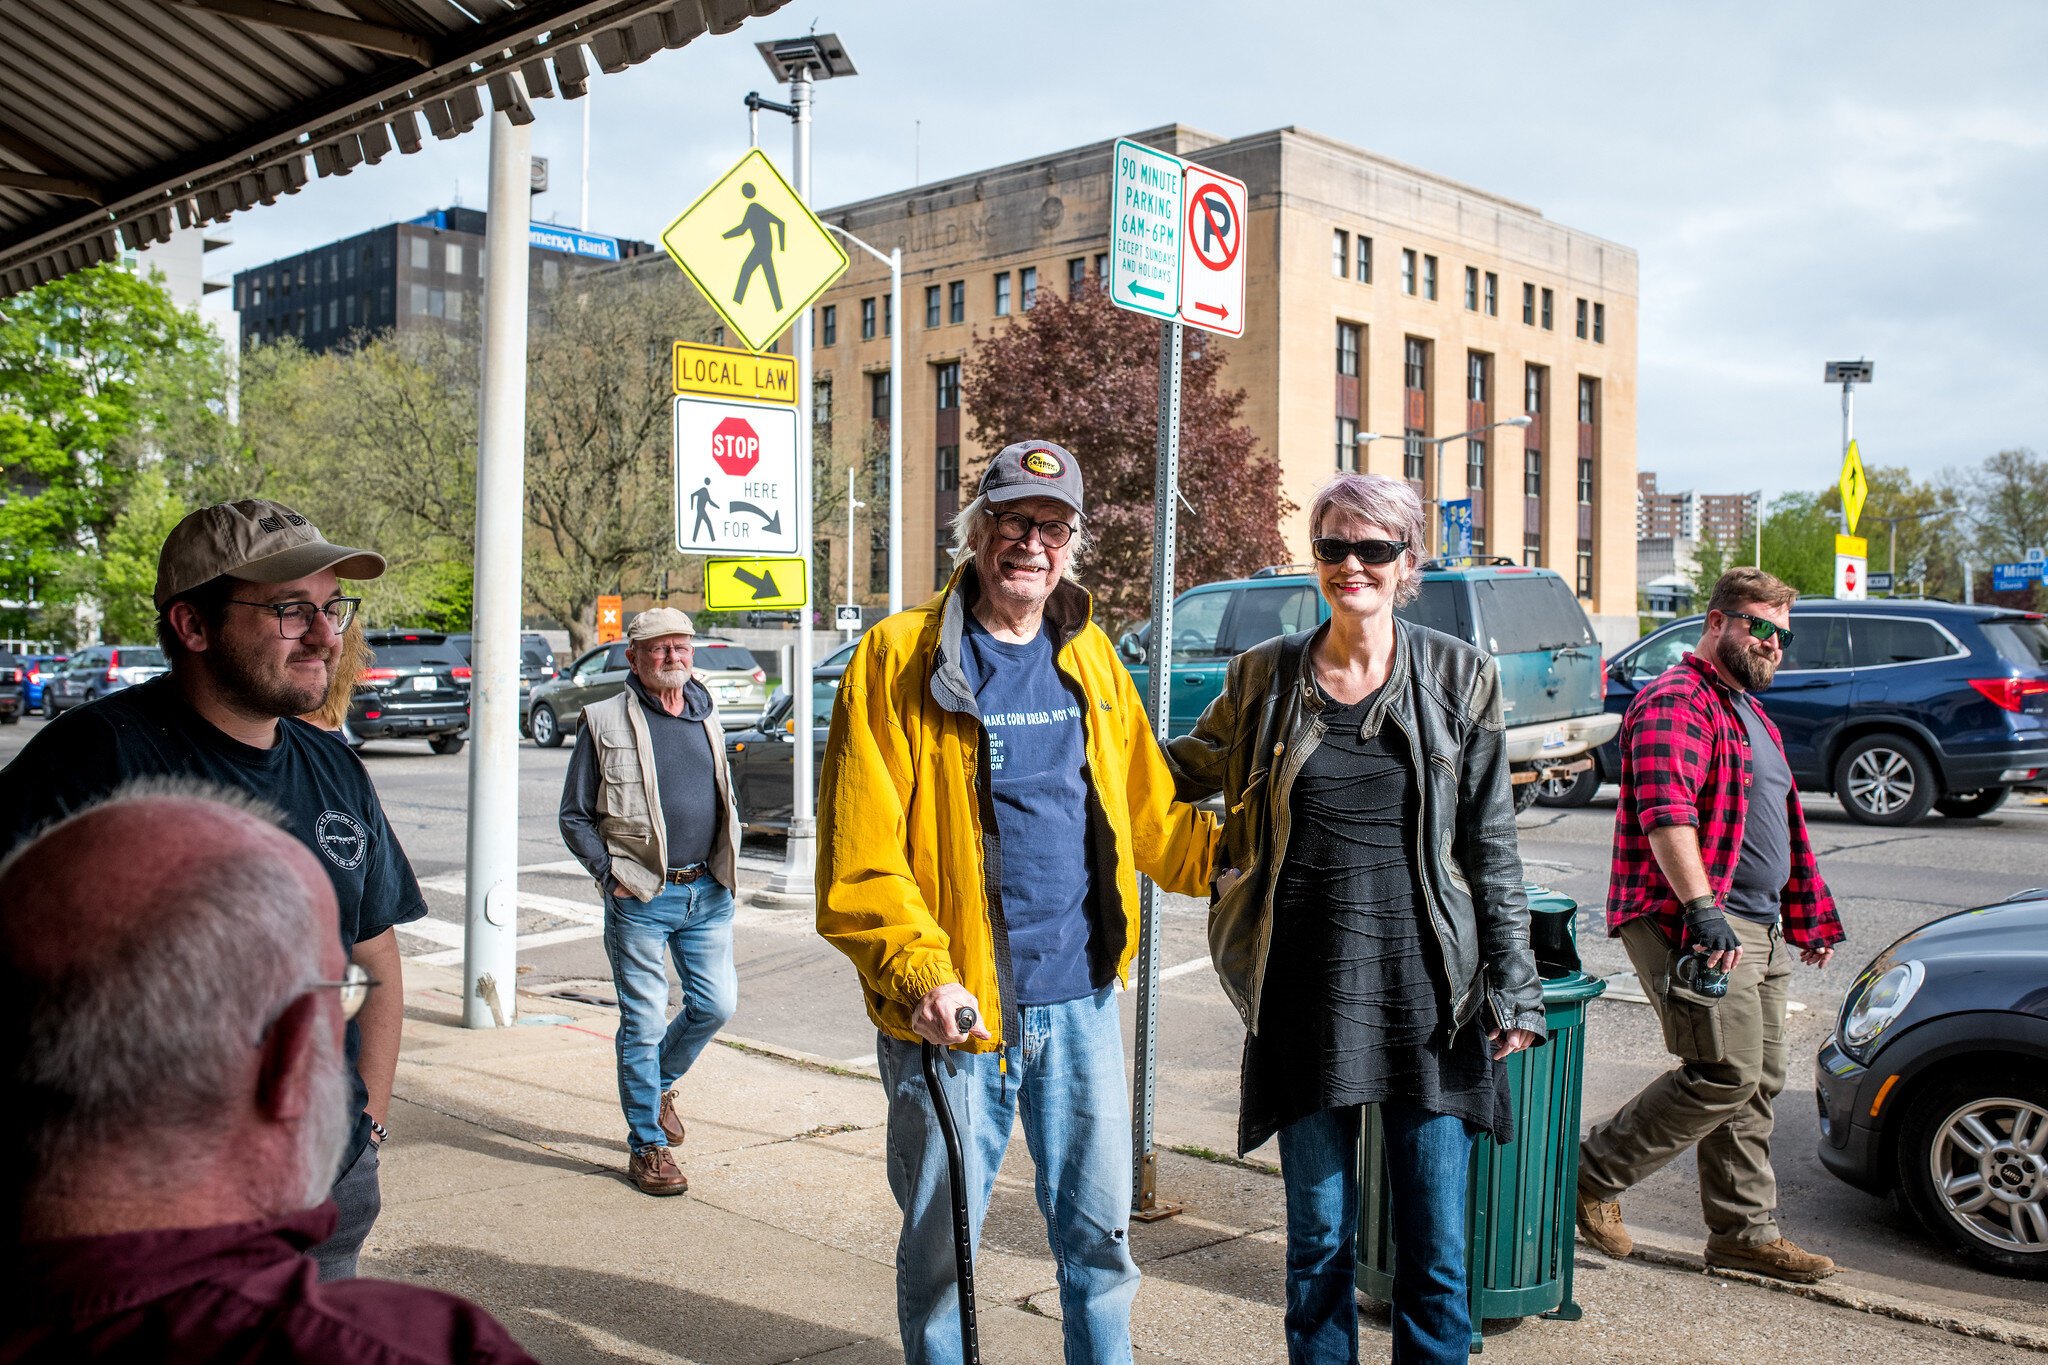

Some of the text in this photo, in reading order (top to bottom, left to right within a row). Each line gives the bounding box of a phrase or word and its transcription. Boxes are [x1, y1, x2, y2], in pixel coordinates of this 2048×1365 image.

[1122, 157, 1177, 194] 90 MINUTE
[1126, 186, 1171, 219] PARKING
[1121, 214, 1174, 246] 6AM-6PM
[577, 238, 611, 257] Bank
[1118, 238, 1176, 267] EXCEPT SUNDAYS
[1122, 258, 1171, 283] AND HOLIDAYS
[683, 357, 789, 391] LOCAL LAW
[713, 434, 759, 459] STOP
[744, 482, 778, 499] HERE
[724, 521, 750, 538] FOR
[2004, 565, 2043, 578] Michi
[983, 714, 1006, 727] MAKE
[1006, 712, 1026, 726] CORN
[1026, 711, 1053, 725] BREAD,
[1051, 709, 1068, 721] NOT
[990, 740, 1004, 748] ORN
[990, 755, 1004, 763] IRLS
[991, 762, 1003, 770] OM
